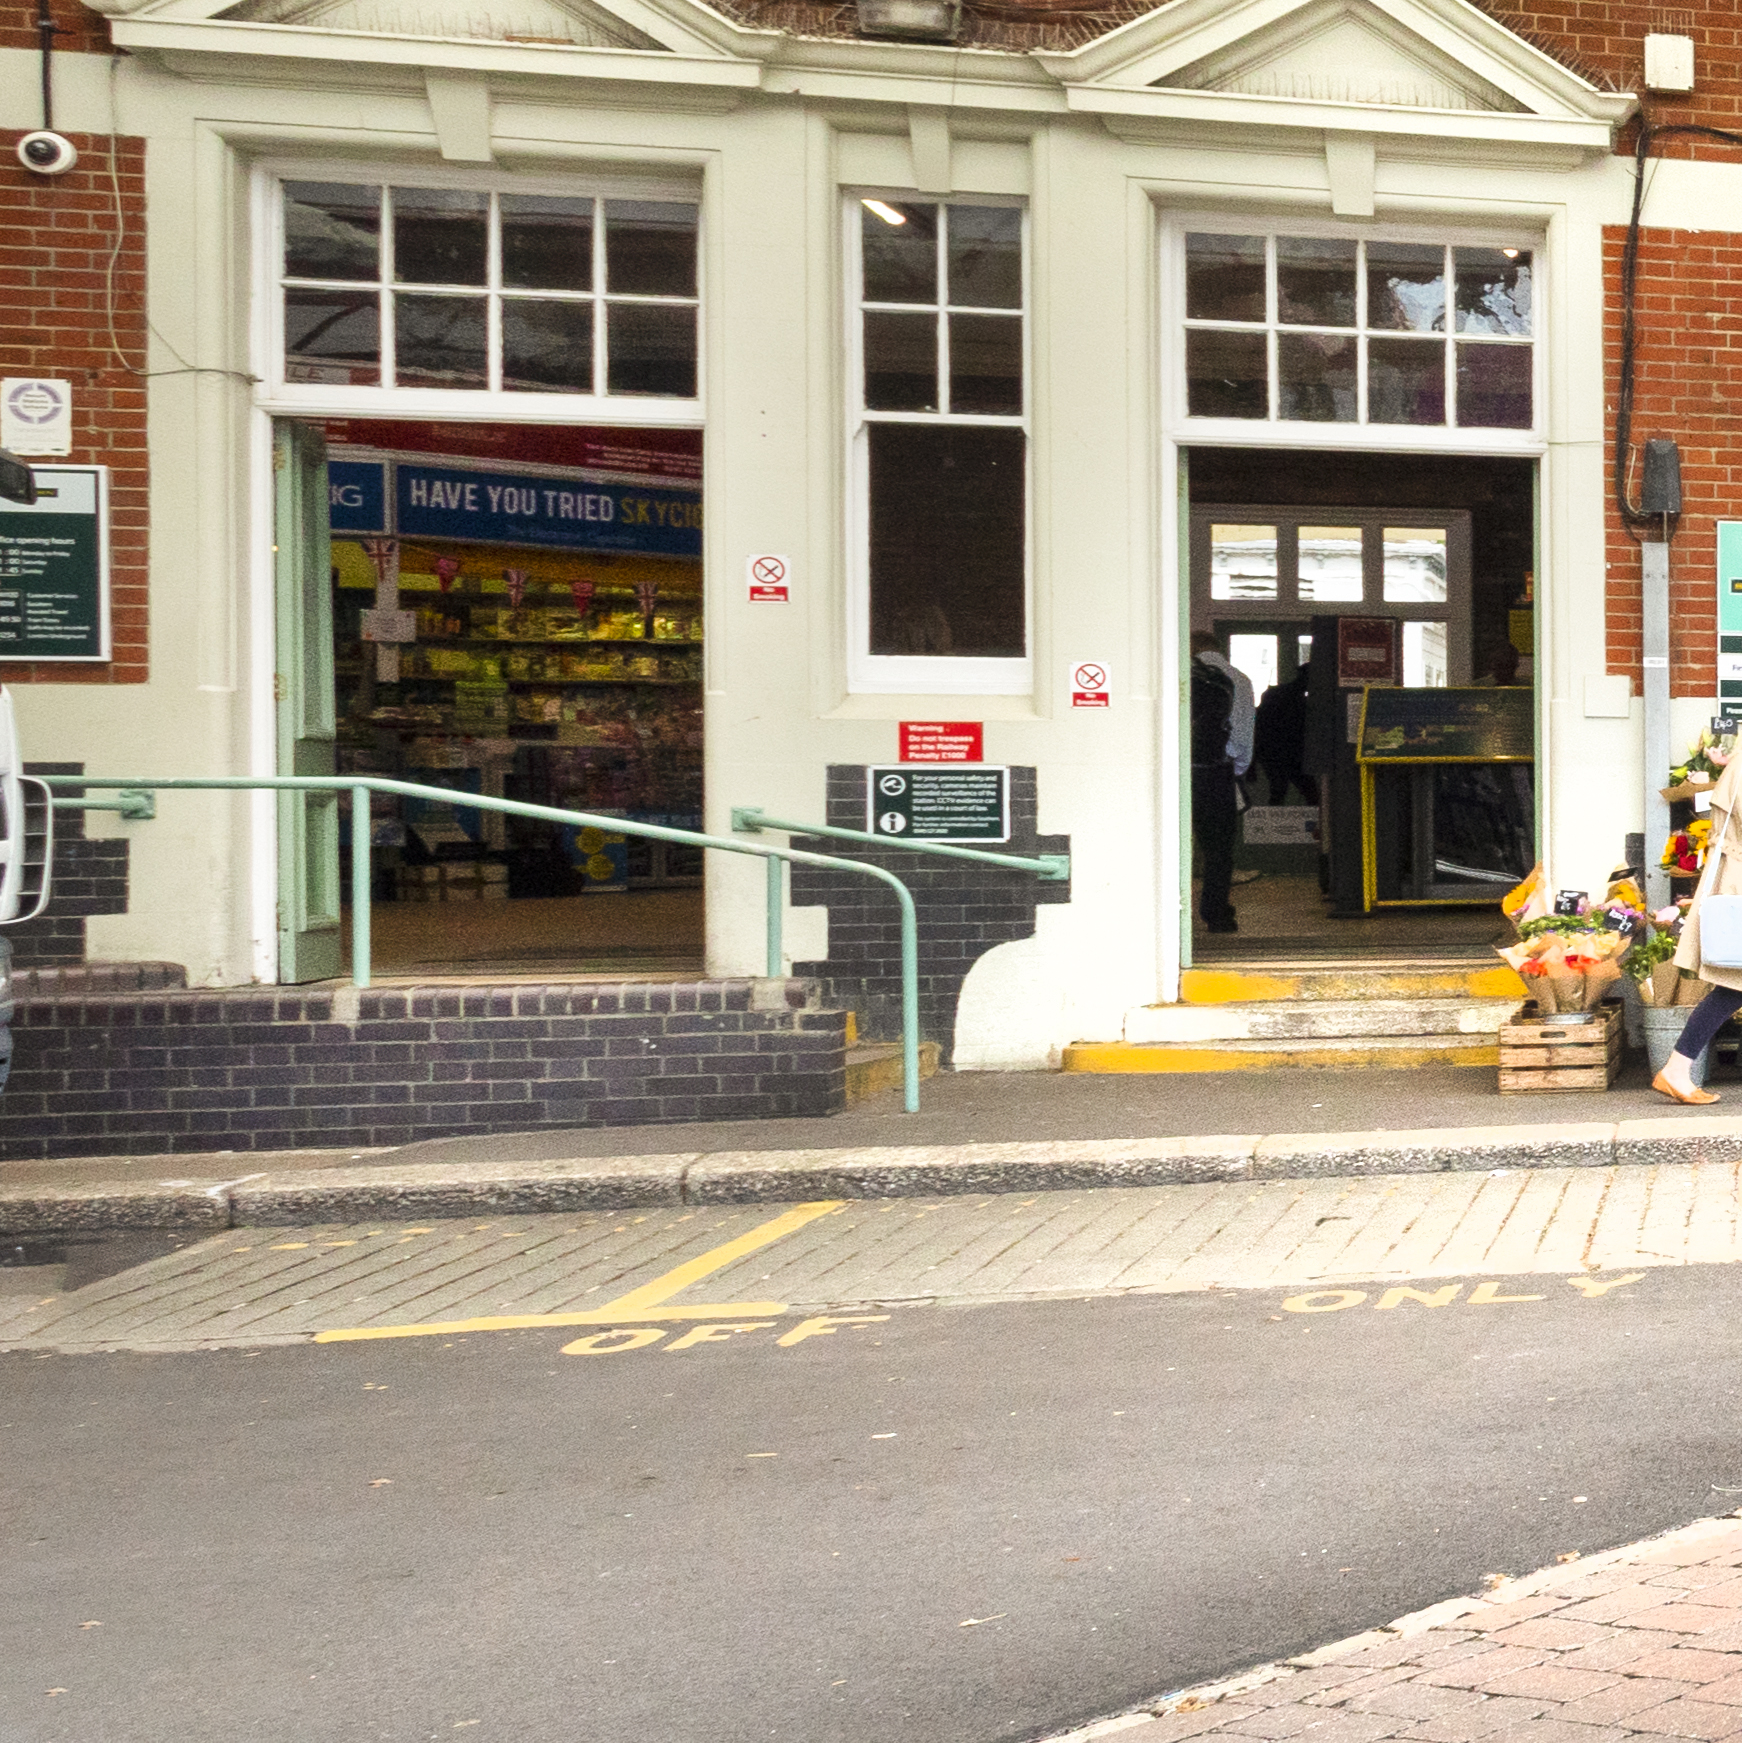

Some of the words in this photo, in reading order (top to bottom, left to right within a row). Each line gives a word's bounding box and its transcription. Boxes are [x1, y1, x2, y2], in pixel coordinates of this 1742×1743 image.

[410, 478, 479, 511] HAVE
[488, 484, 536, 516] YOU
[543, 489, 614, 522] TRIED
[908, 725, 944, 733] Warning
[937, 744, 969, 752] Railway
[909, 752, 940, 760] Penalty
[559, 1314, 892, 1355] OFF
[1280, 1272, 1647, 1313] ONLY
